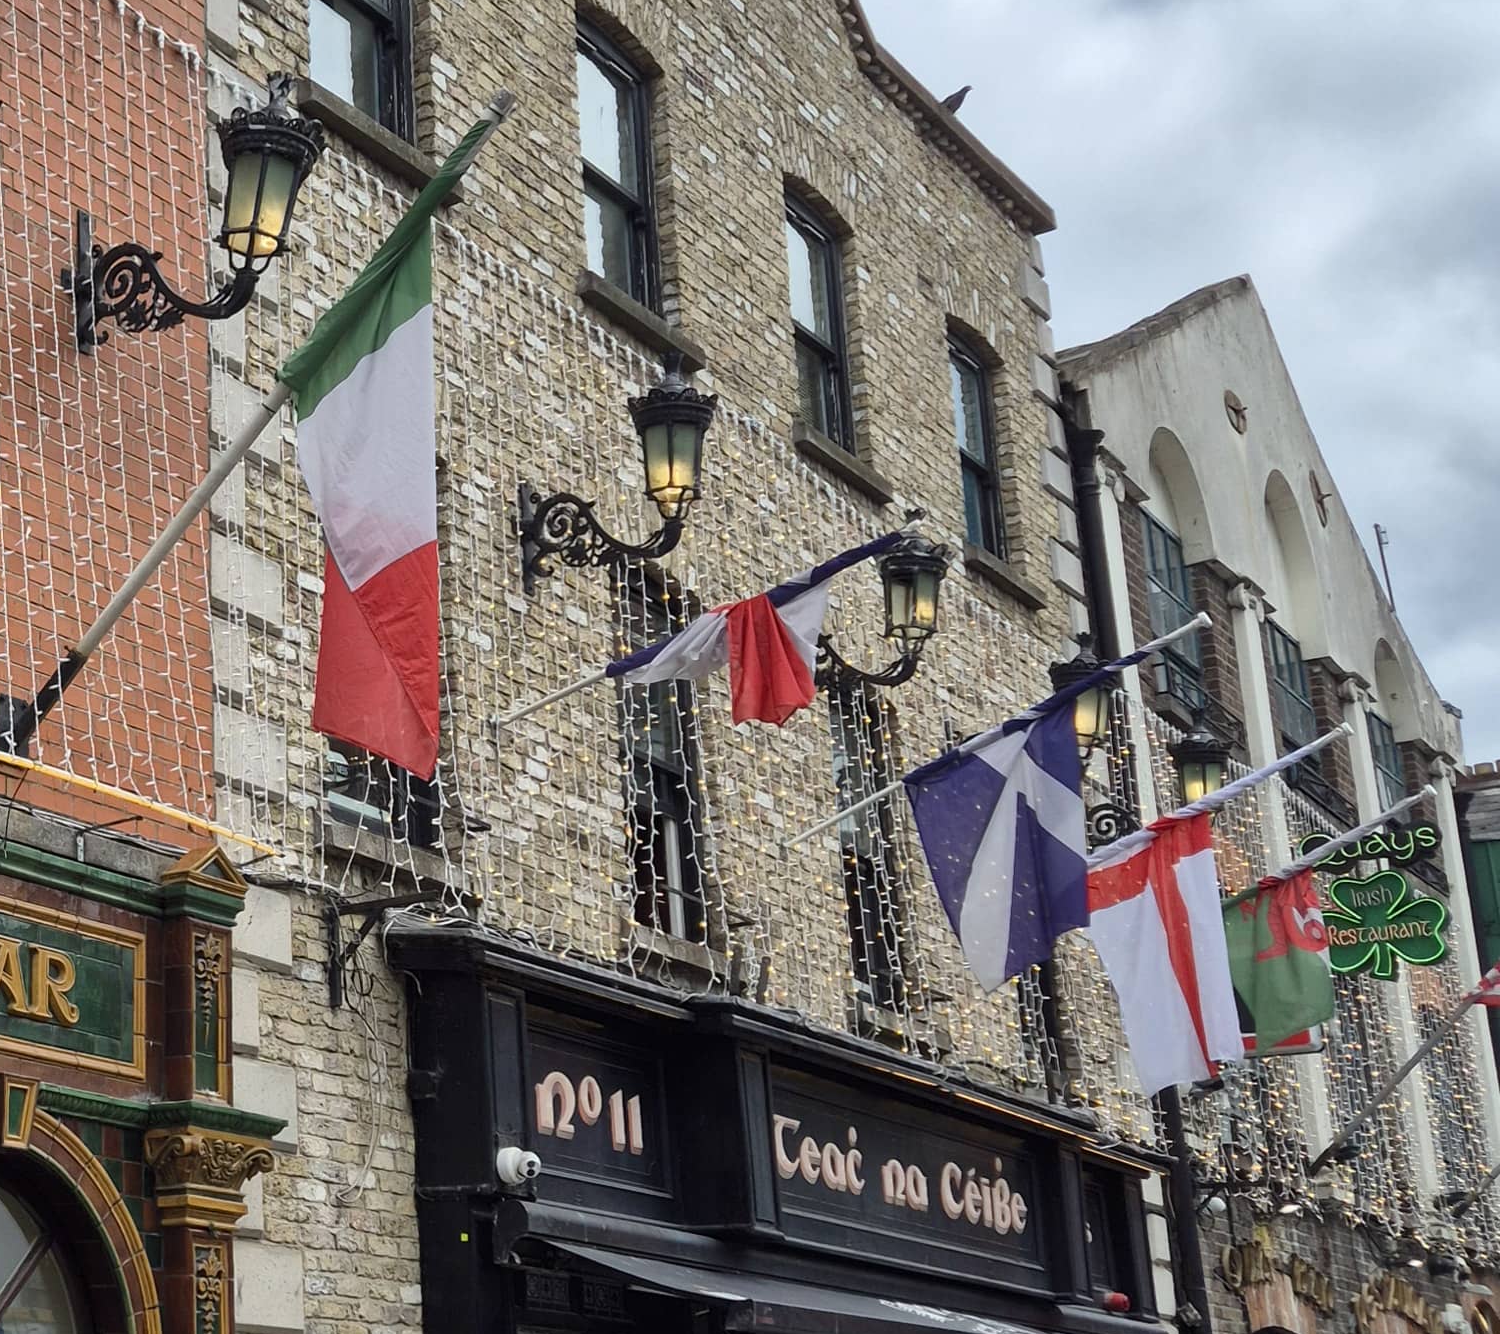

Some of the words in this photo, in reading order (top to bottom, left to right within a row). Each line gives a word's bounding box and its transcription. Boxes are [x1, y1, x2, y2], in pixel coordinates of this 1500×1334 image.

[1299, 827, 1437, 868] Quays
[1351, 885, 1394, 909] Irish
[1326, 920, 1434, 947] Restaurant
[609, 1088, 645, 1156] 11
[881, 1158, 930, 1212] na
